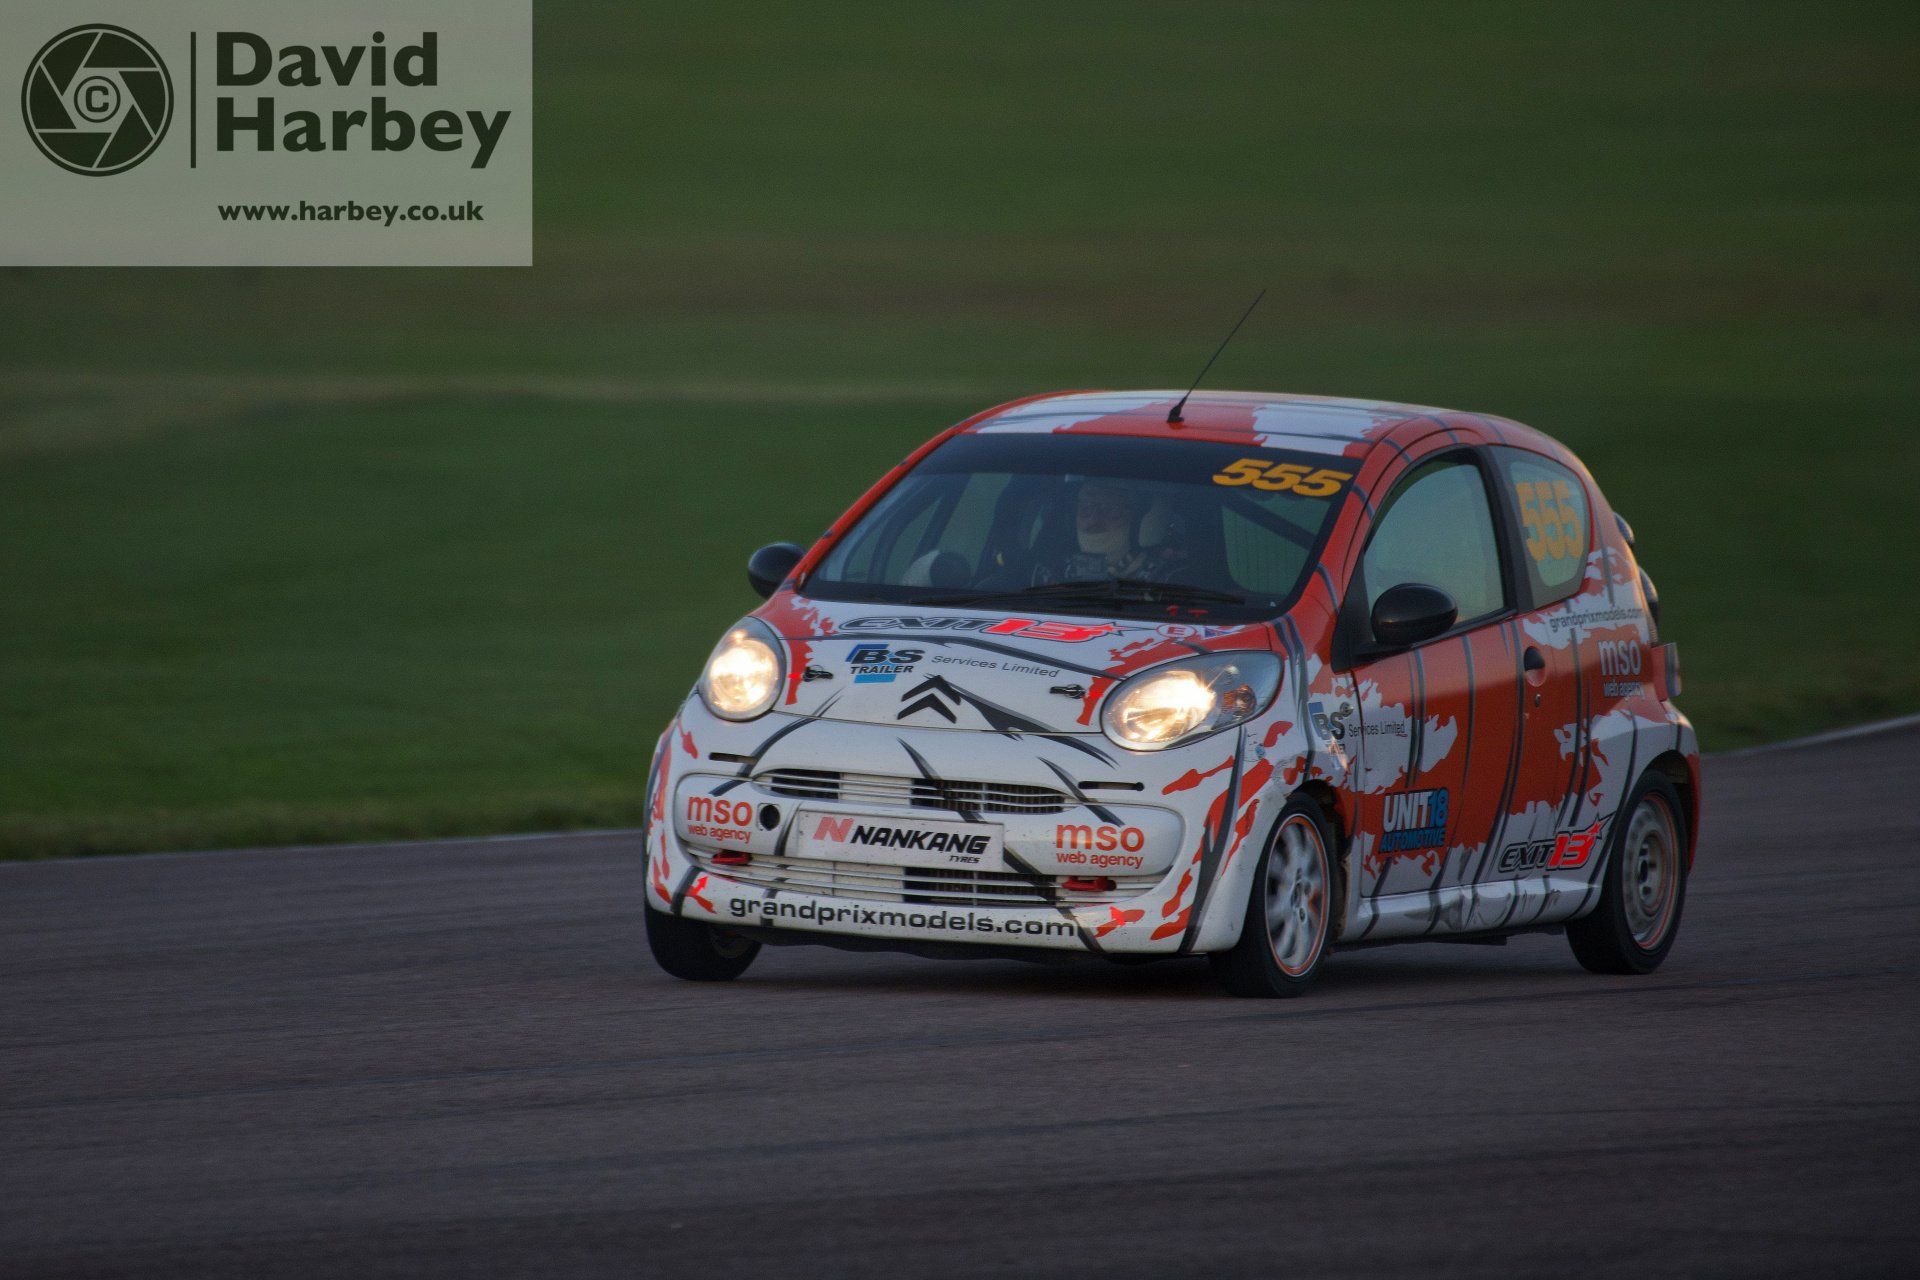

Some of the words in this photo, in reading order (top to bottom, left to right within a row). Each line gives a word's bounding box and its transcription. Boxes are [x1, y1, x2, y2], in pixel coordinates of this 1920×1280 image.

[1212, 458, 1354, 498] 555
[1516, 480, 1585, 562] 555
[850, 665, 915, 675] TRAILER
[851, 649, 927, 665] BS
[931, 655, 997, 670] Services
[1002, 661, 1061, 679] Limited
[1598, 639, 1642, 676] mso
[686, 796, 753, 827] mso
[688, 823, 708, 836] web
[708, 825, 751, 844] agency
[851, 824, 992, 855] NANKANG
[1055, 823, 1145, 853] mso
[949, 855, 981, 865] TYRES
[1055, 850, 1087, 865] web
[1090, 851, 1144, 870] agency
[730, 897, 1075, 937] grandprixmodels.com
